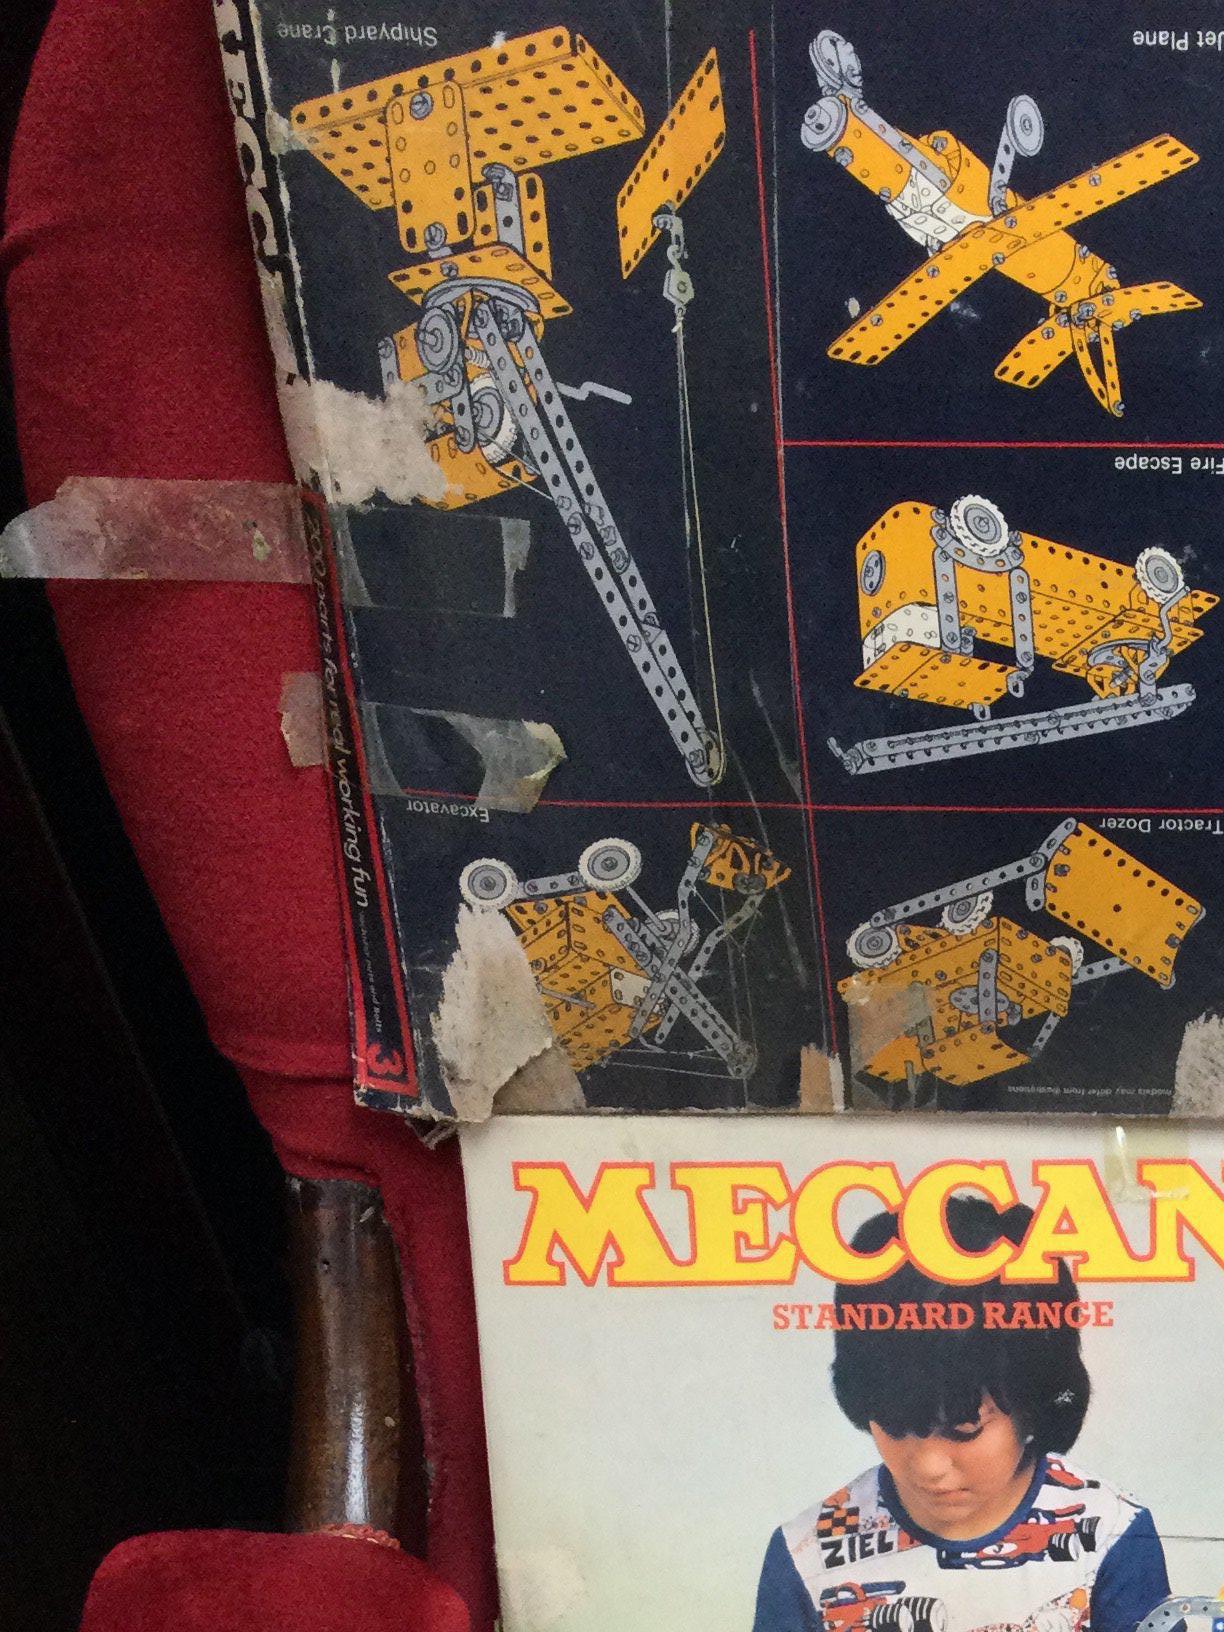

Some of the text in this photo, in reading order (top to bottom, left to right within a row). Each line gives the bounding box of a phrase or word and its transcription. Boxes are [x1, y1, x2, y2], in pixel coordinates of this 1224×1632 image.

[278, 22, 438, 47] Shipyard Crane
[1132, 30, 1189, 51] Plane
[1114, 452, 1182, 474] Escape
[406, 800, 490, 823] Excavator
[335, 757, 362, 861] working
[352, 863, 372, 909] fun
[1100, 817, 1224, 835] Tractor Dozer
[366, 1041, 403, 1078] 3
[772, 1301, 1114, 1331] STANDARD RANGE
[821, 1530, 894, 1569] ZIEL
